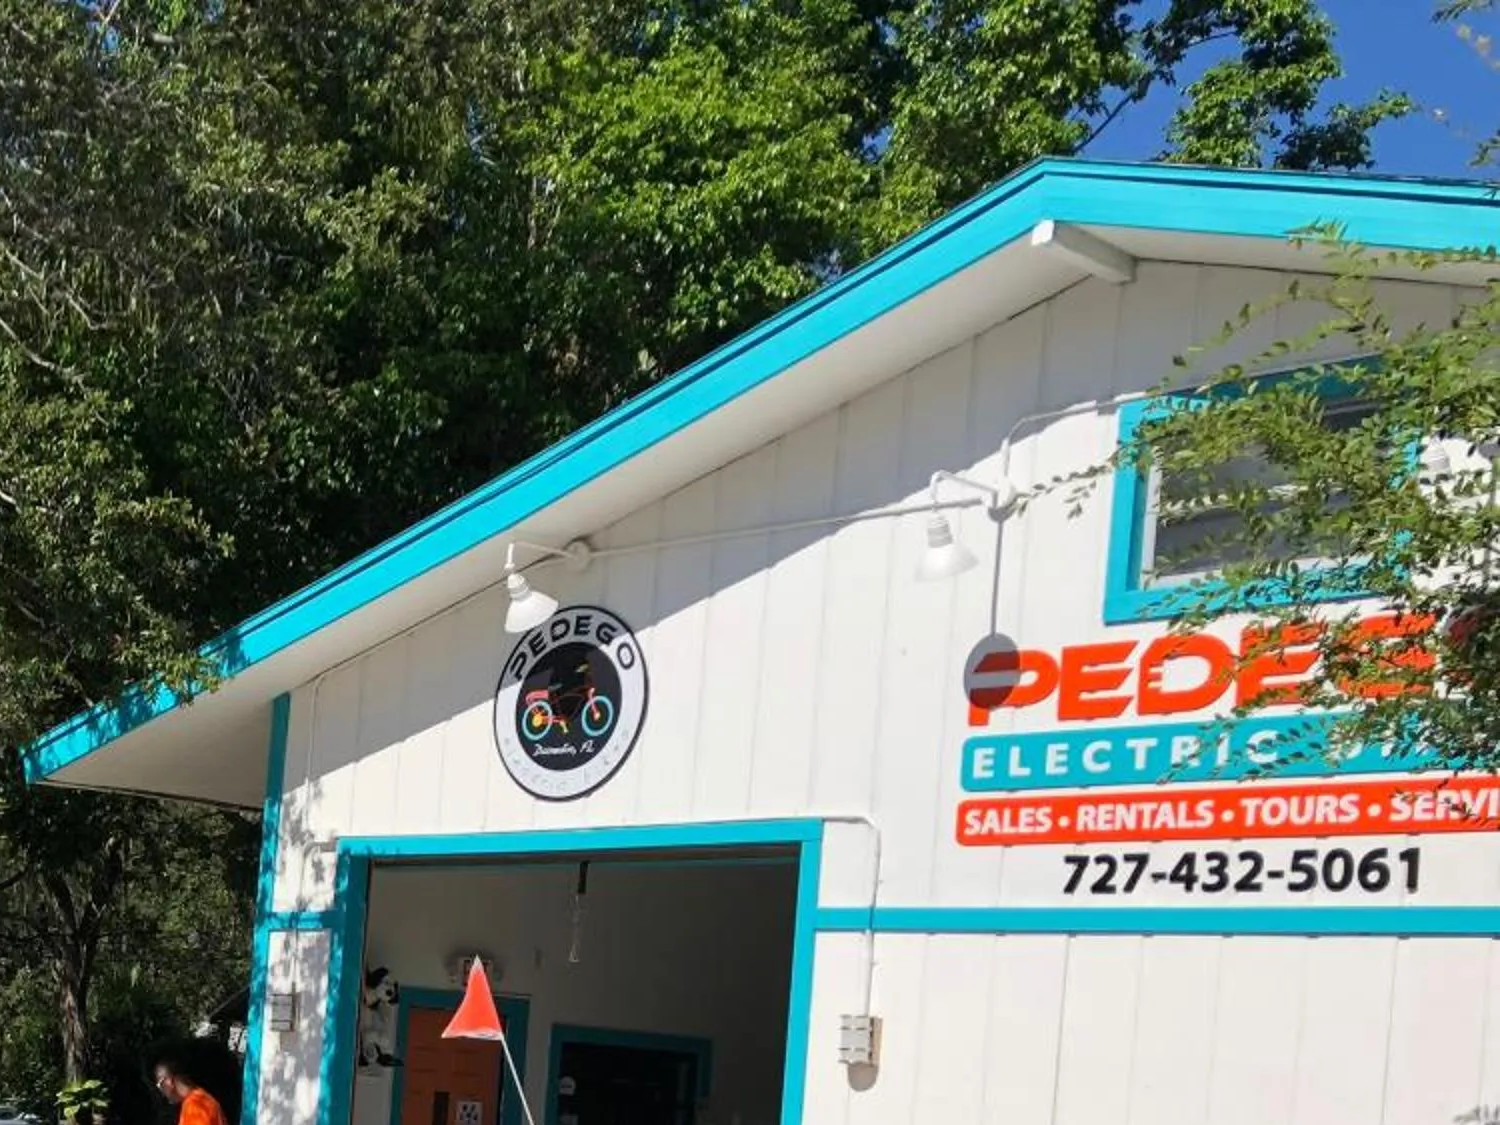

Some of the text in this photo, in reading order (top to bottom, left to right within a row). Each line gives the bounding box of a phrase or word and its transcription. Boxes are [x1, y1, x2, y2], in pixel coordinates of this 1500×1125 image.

[510, 615, 635, 681] PEDEGO
[967, 612, 1440, 727] PEDEG
[972, 728, 1279, 780] ELECTRIC
[963, 804, 1053, 836] SALES
[1076, 799, 1215, 833] RENTALS
[1240, 794, 1361, 828] TOURS
[1062, 846, 1422, 895] 727-432-5061
